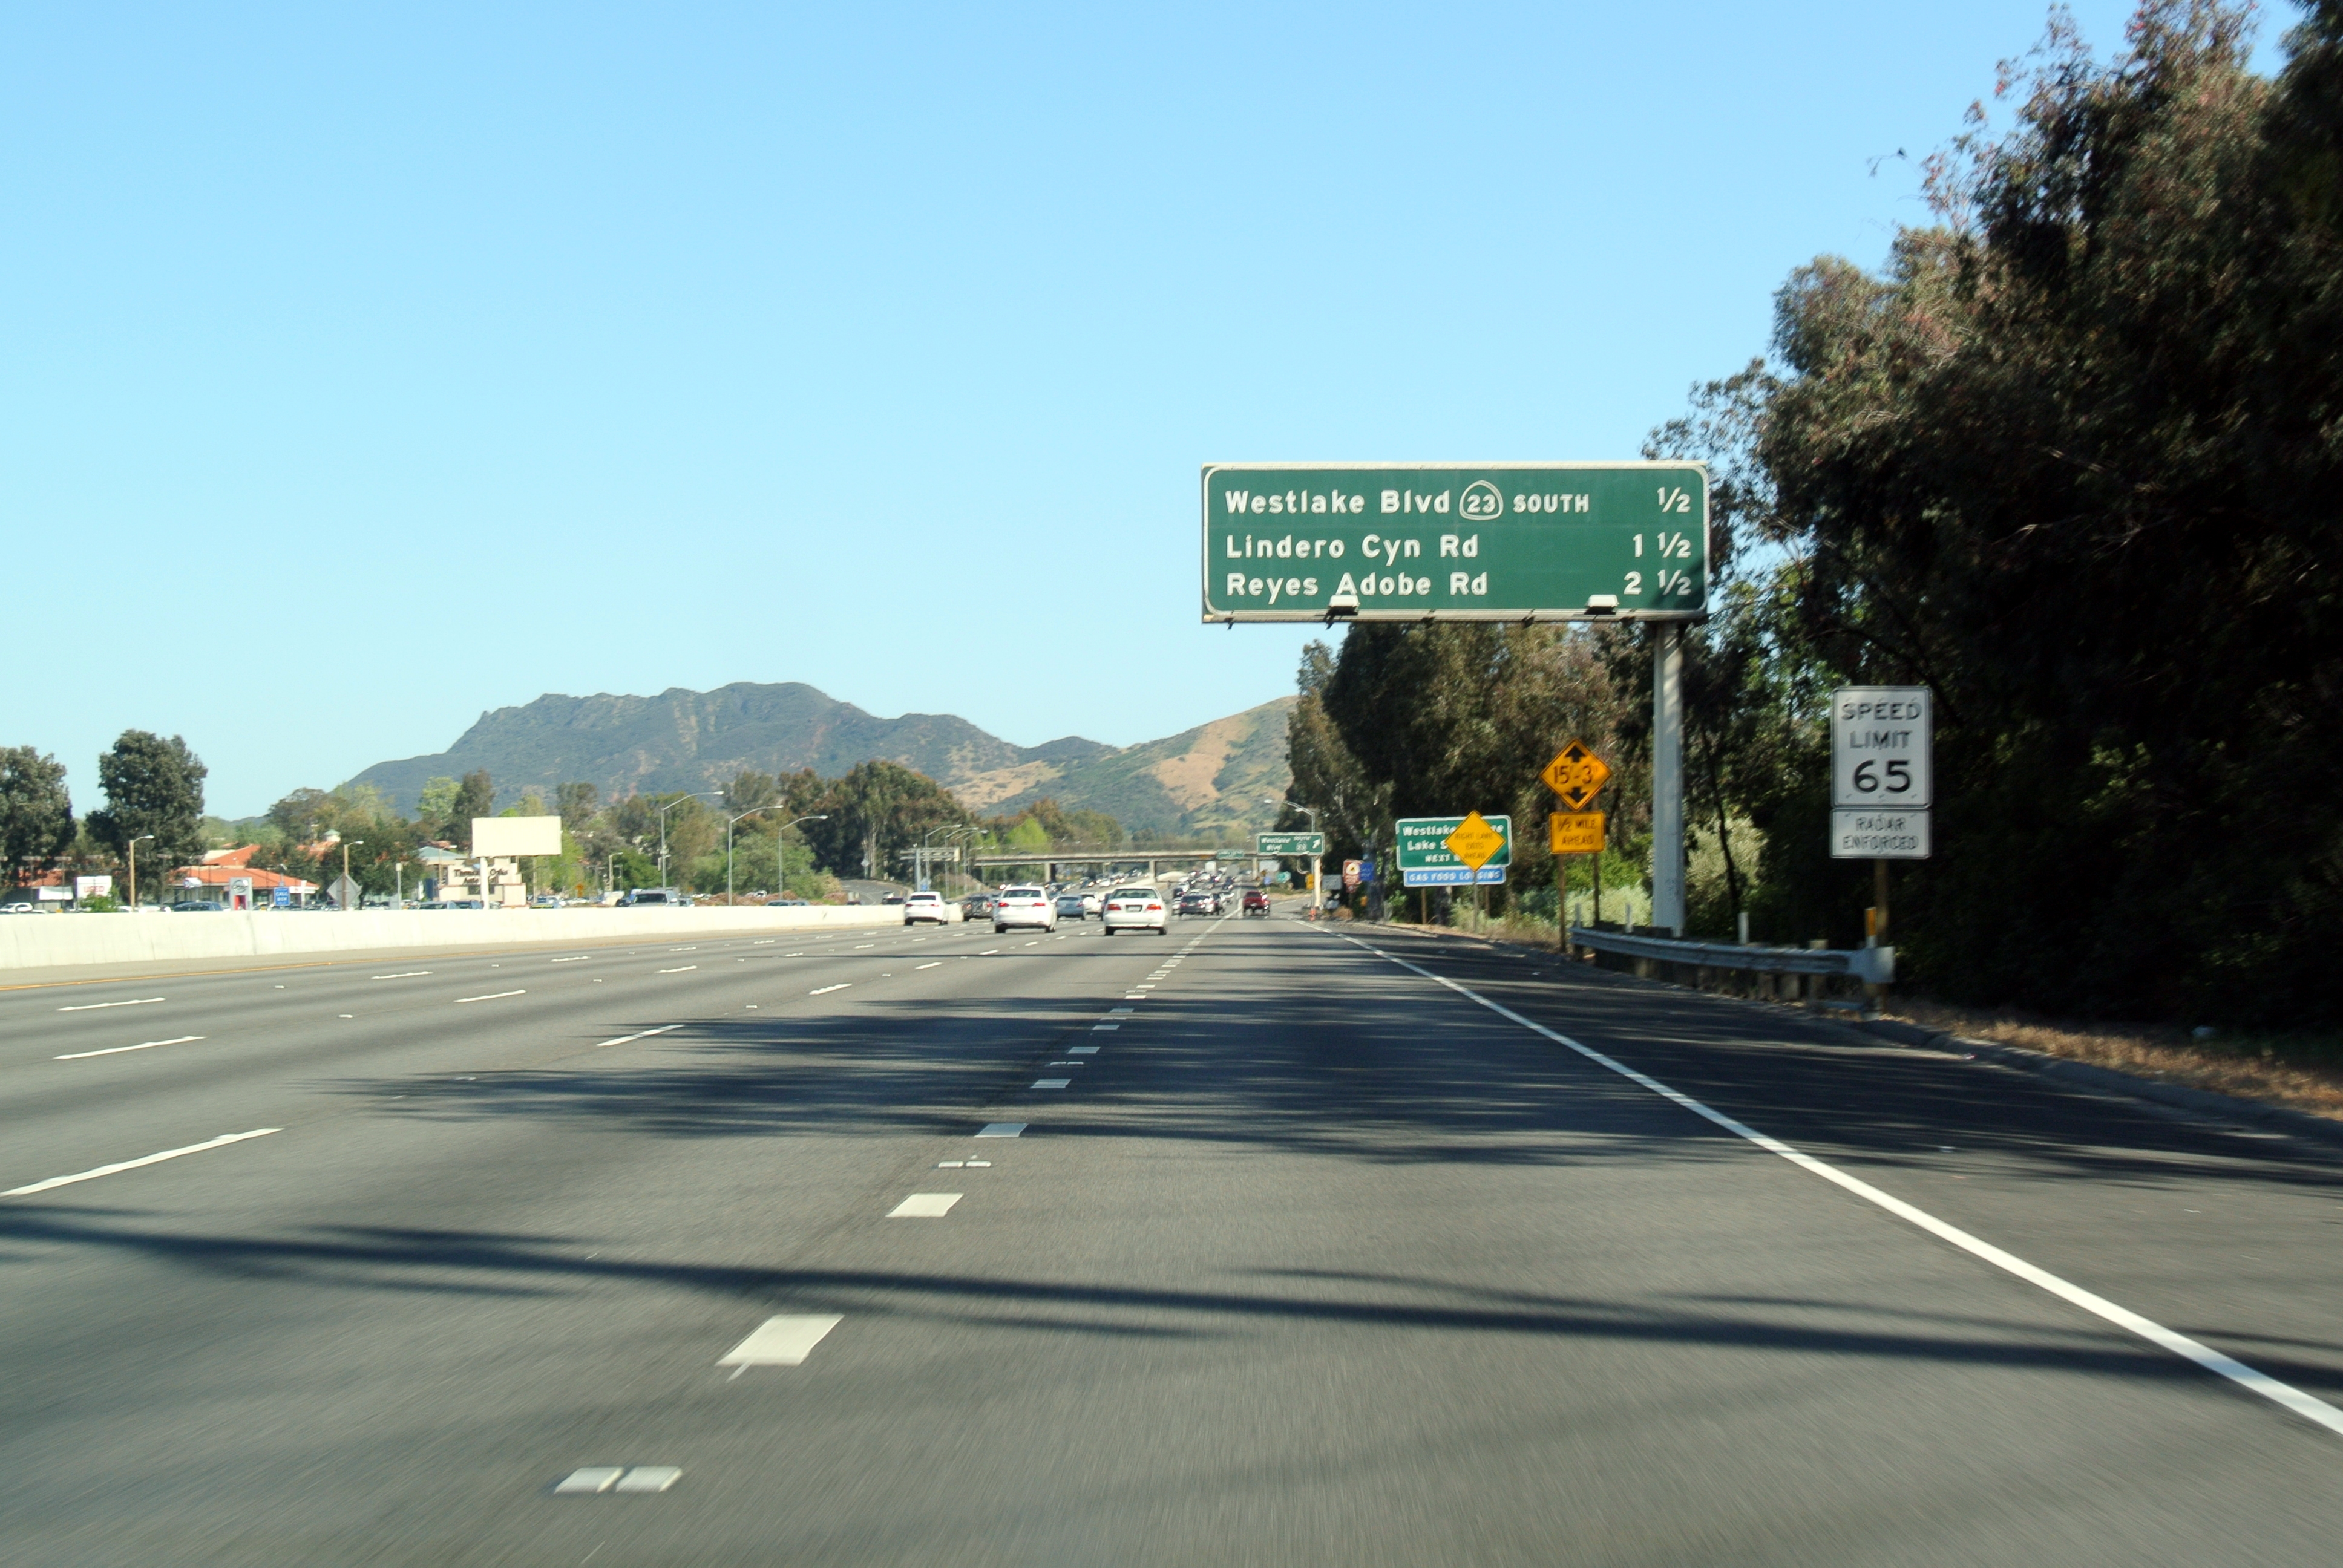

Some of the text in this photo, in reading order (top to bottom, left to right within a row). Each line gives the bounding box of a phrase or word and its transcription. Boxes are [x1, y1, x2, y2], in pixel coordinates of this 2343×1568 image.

[1225, 489, 1365, 514] Westlake
[1381, 489, 1450, 514] Blvd
[1466, 494, 1496, 513] 23
[1513, 494, 1589, 513] SOUTH
[1227, 534, 1345, 558] Lindero
[1362, 534, 1420, 566] Cyn
[1440, 534, 1478, 558] Rd
[1227, 572, 1319, 604] Reyes
[1335, 572, 1432, 596] Adobe
[1450, 571, 1487, 595] Rd
[1624, 571, 1642, 595] 2
[1841, 702, 1922, 720] SPEED
[1849, 730, 1912, 750] LIMIT
[1852, 760, 1912, 794] 65
[1403, 825, 1457, 836] Westlake
[1575, 818, 1597, 829] MILE
[1855, 818, 1906, 832] RADAR
[1407, 840, 1436, 851] Lake
[1561, 835, 1594, 846] AHEAD
[1843, 835, 1919, 851] ENFORCED
[1425, 854, 1450, 863] NEXT
[1409, 872, 1429, 881] GAS
[1431, 872, 1457, 880] FOOD
